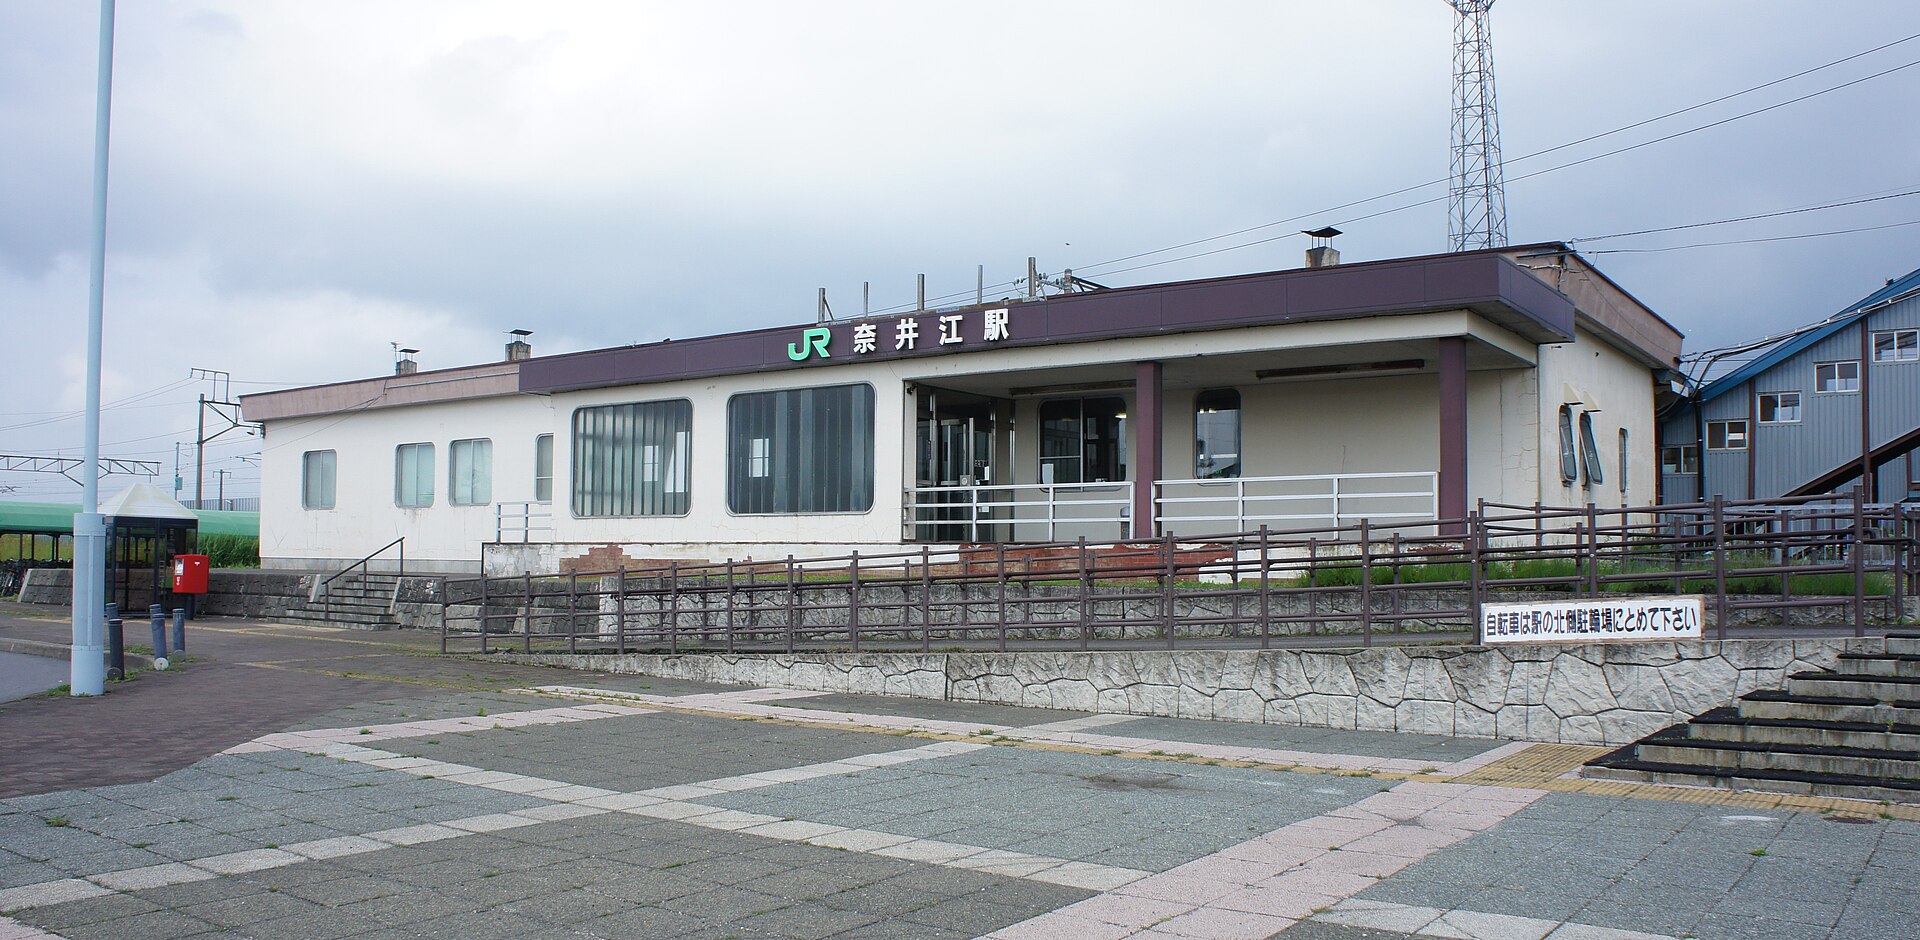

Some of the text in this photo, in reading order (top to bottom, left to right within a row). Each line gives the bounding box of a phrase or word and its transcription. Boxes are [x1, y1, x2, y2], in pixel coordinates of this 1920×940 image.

[788, 308, 1009, 361] JR 奈井江駅
[1486, 606, 1696, 637] 自転車は駅の北側駐輪場にとめて下さい
